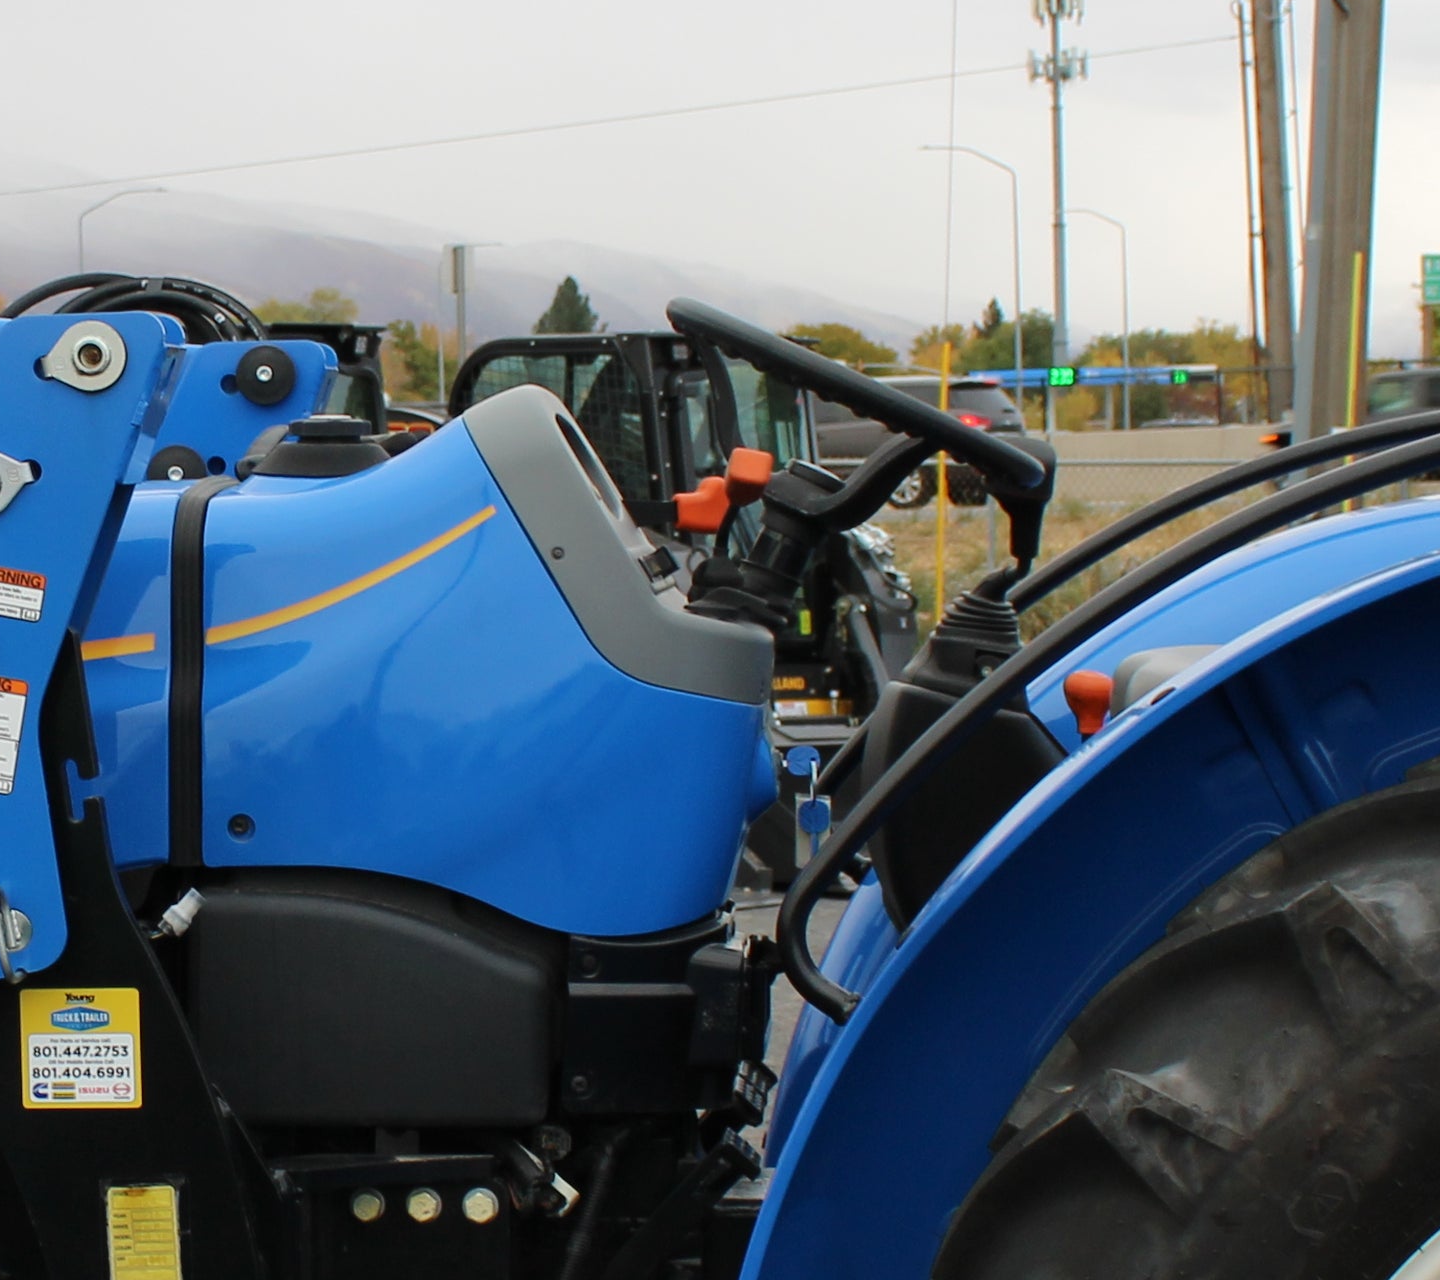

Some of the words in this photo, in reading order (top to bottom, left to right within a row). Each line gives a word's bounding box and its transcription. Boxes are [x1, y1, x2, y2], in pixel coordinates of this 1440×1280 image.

[65, 993, 95, 1003] Young
[33, 1046, 129, 1058] 801.447.2753
[32, 1067, 131, 1079] 801.404.6991
